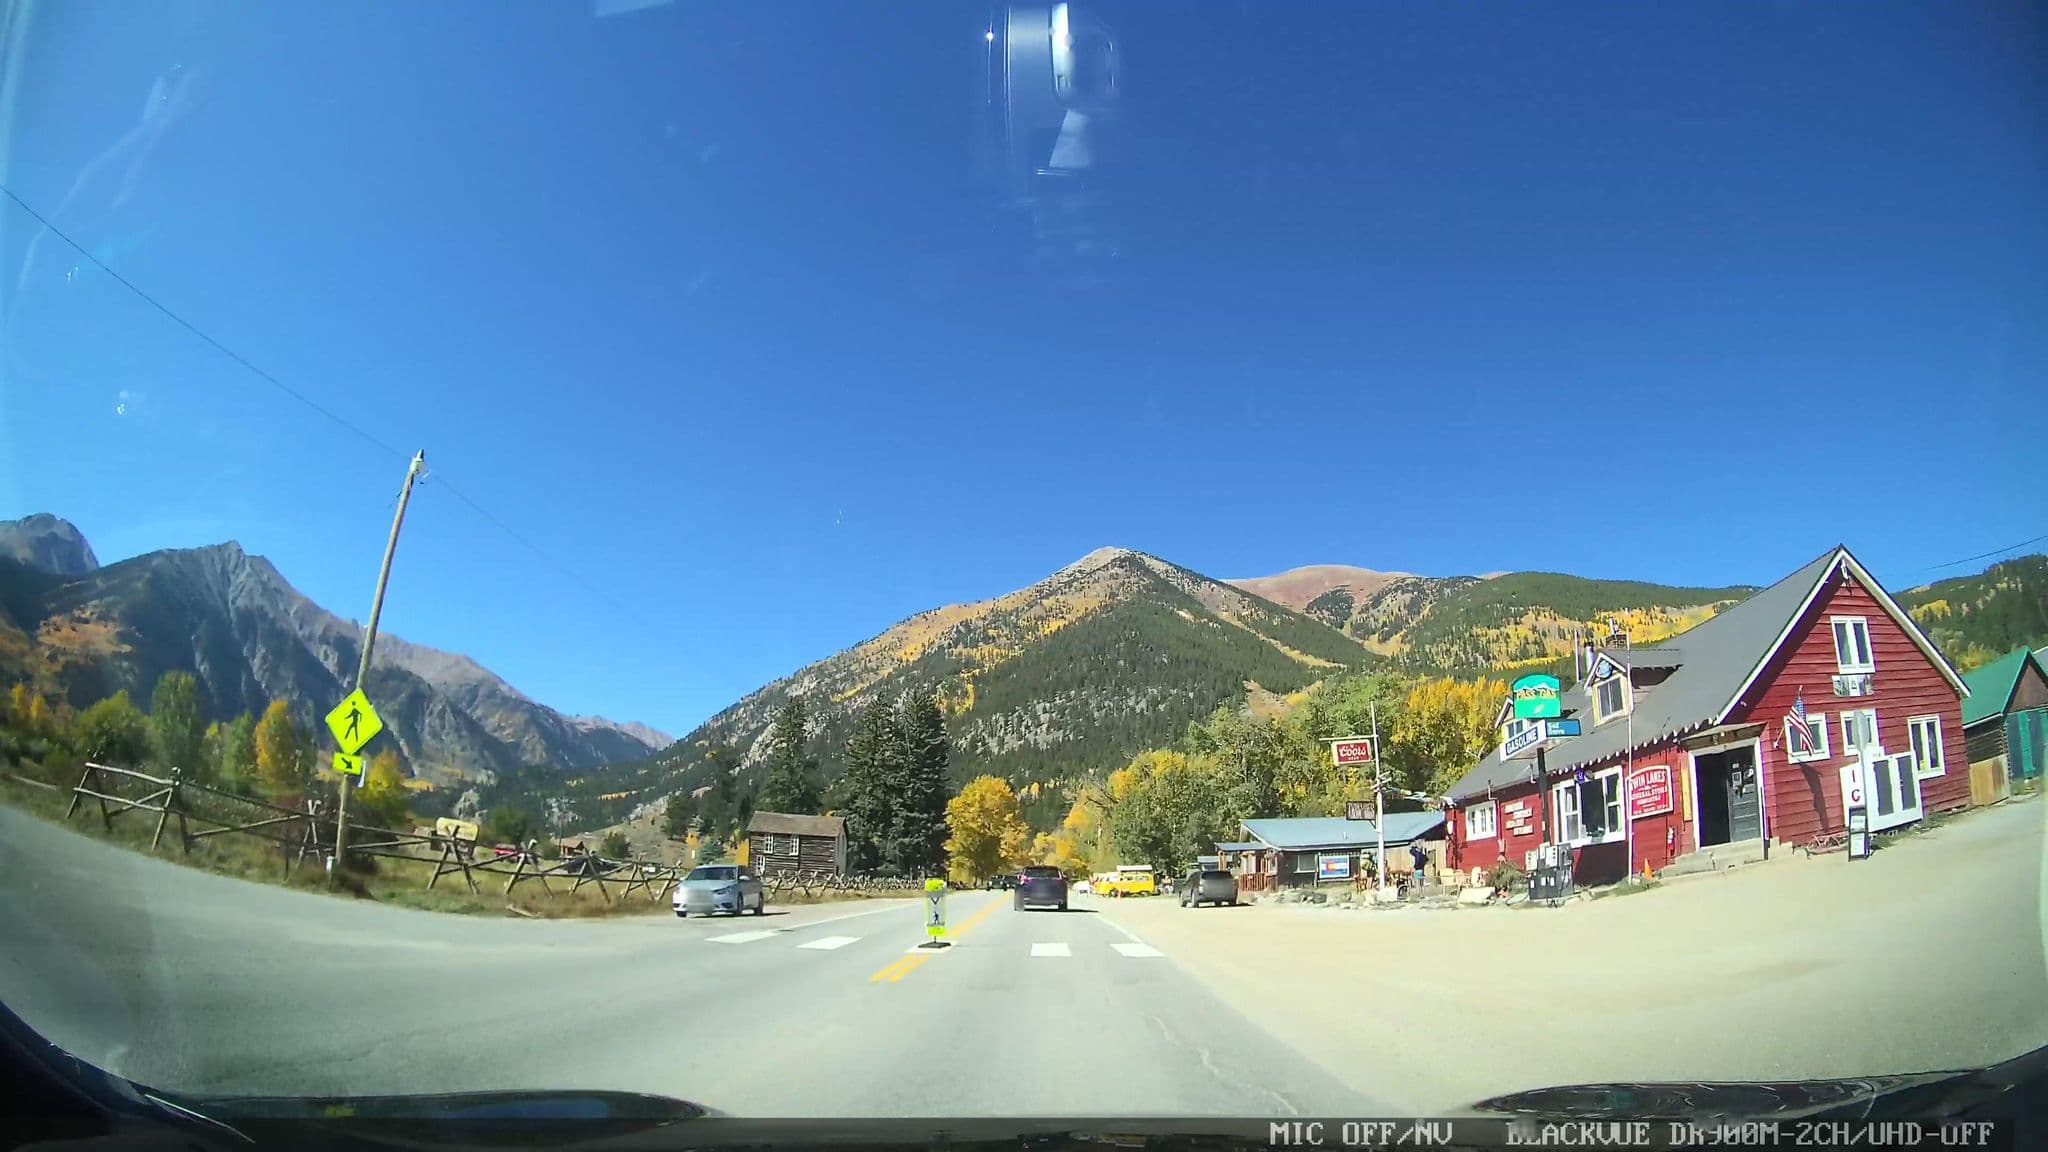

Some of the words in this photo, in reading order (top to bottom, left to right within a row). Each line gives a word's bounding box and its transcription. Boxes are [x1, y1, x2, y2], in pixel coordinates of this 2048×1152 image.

[1507, 729, 1538, 754] GASOLINE
[1339, 745, 1366, 757] Coors
[1645, 770, 1666, 785] LAKES
